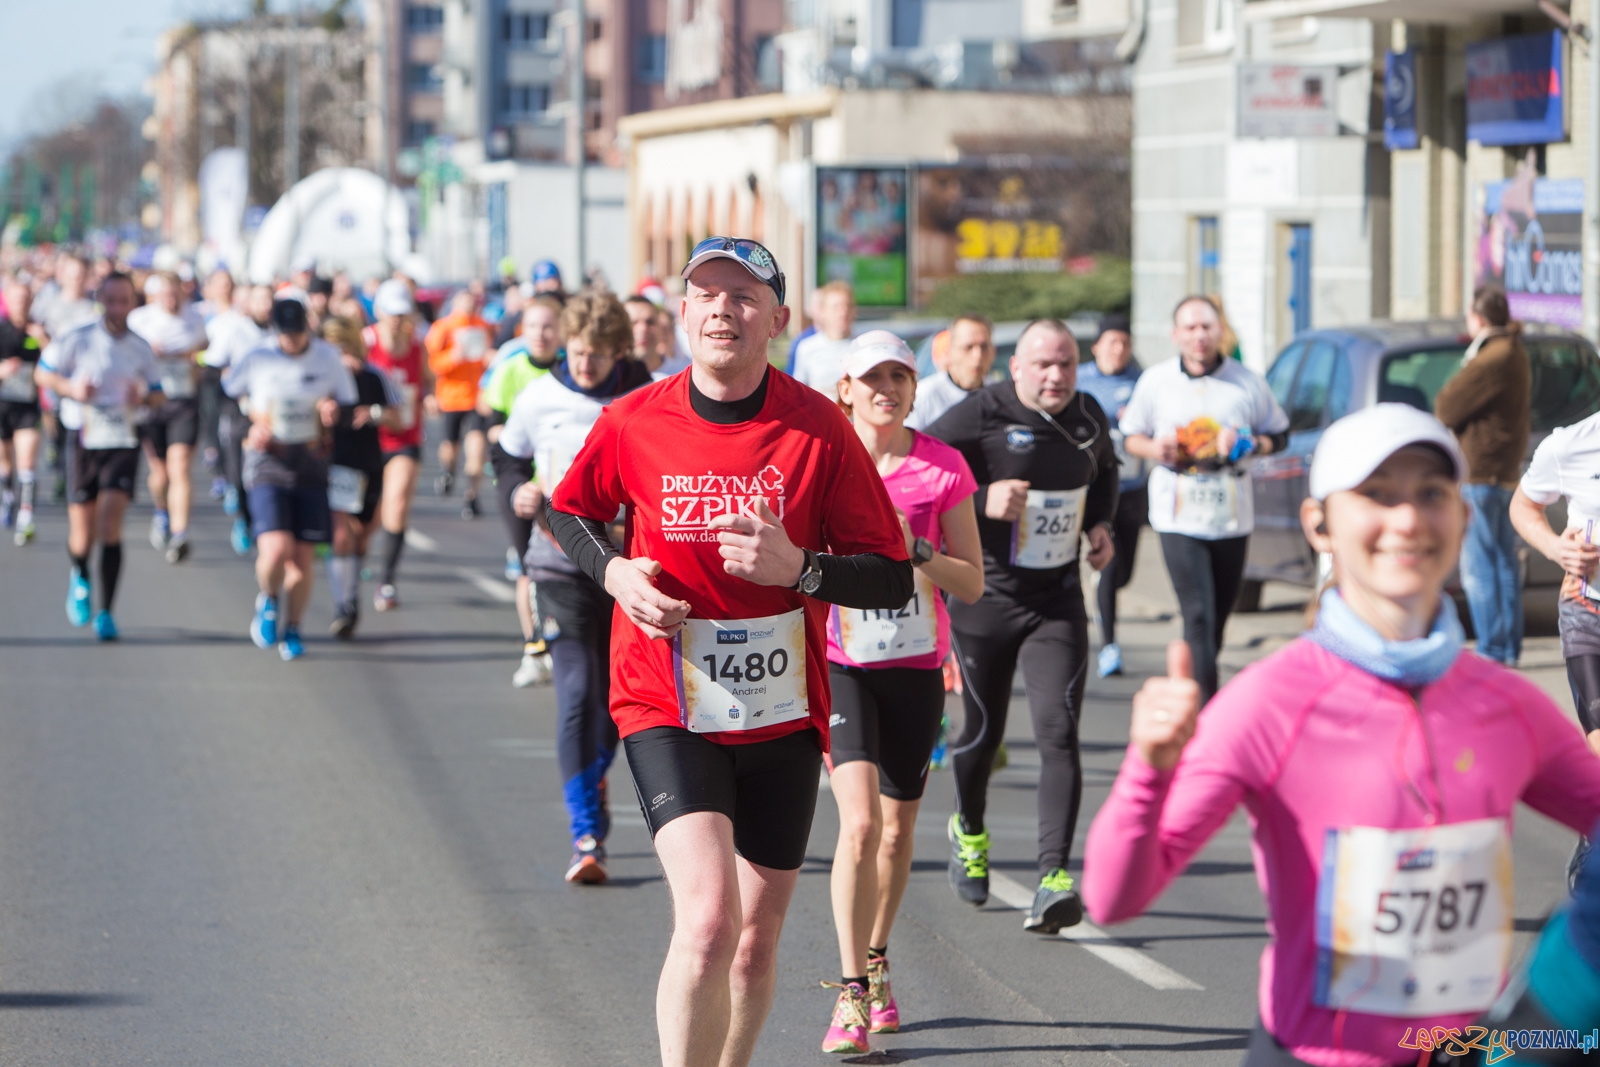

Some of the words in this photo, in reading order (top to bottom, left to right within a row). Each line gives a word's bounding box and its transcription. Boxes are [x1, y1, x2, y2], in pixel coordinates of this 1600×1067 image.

[661, 470, 764, 494] DRUŻYNA
[730, 633, 746, 641] PKO
[702, 648, 788, 683] 1480
[731, 685, 767, 696] Andrzej
[1374, 880, 1488, 935] 5787
